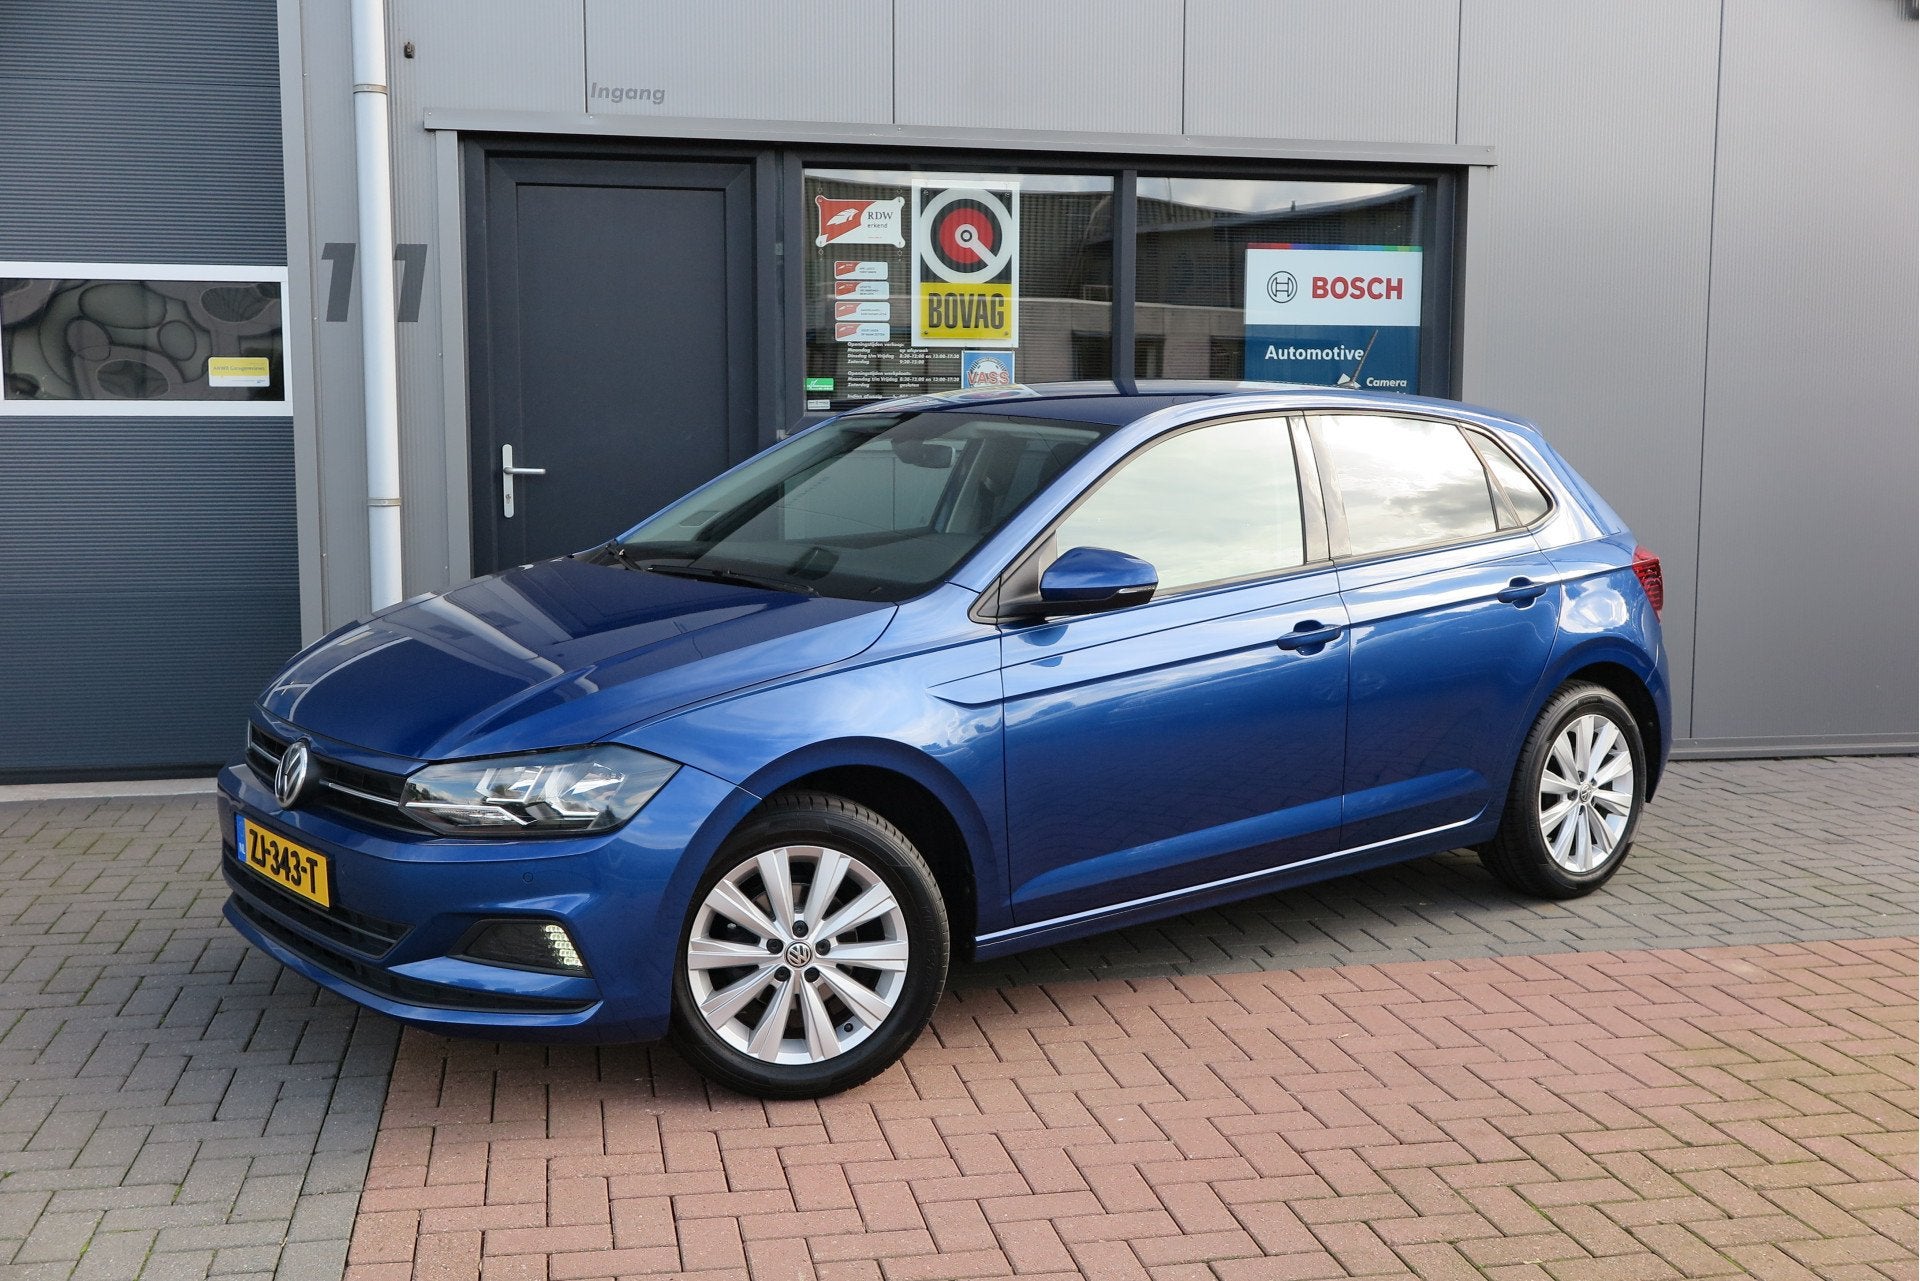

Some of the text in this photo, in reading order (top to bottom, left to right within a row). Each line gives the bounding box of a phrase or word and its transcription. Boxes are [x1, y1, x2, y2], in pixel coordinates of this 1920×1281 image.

[590, 82, 665, 105] Ingang
[867, 211, 894, 220] RDW
[1311, 276, 1403, 300] BOSCH
[928, 292, 1005, 330] BOVAG
[1264, 344, 1365, 361] Automotive
[967, 370, 1010, 385] VASS
[1366, 376, 1407, 387] Camera
[249, 828, 318, 895] ZJ-343-T
